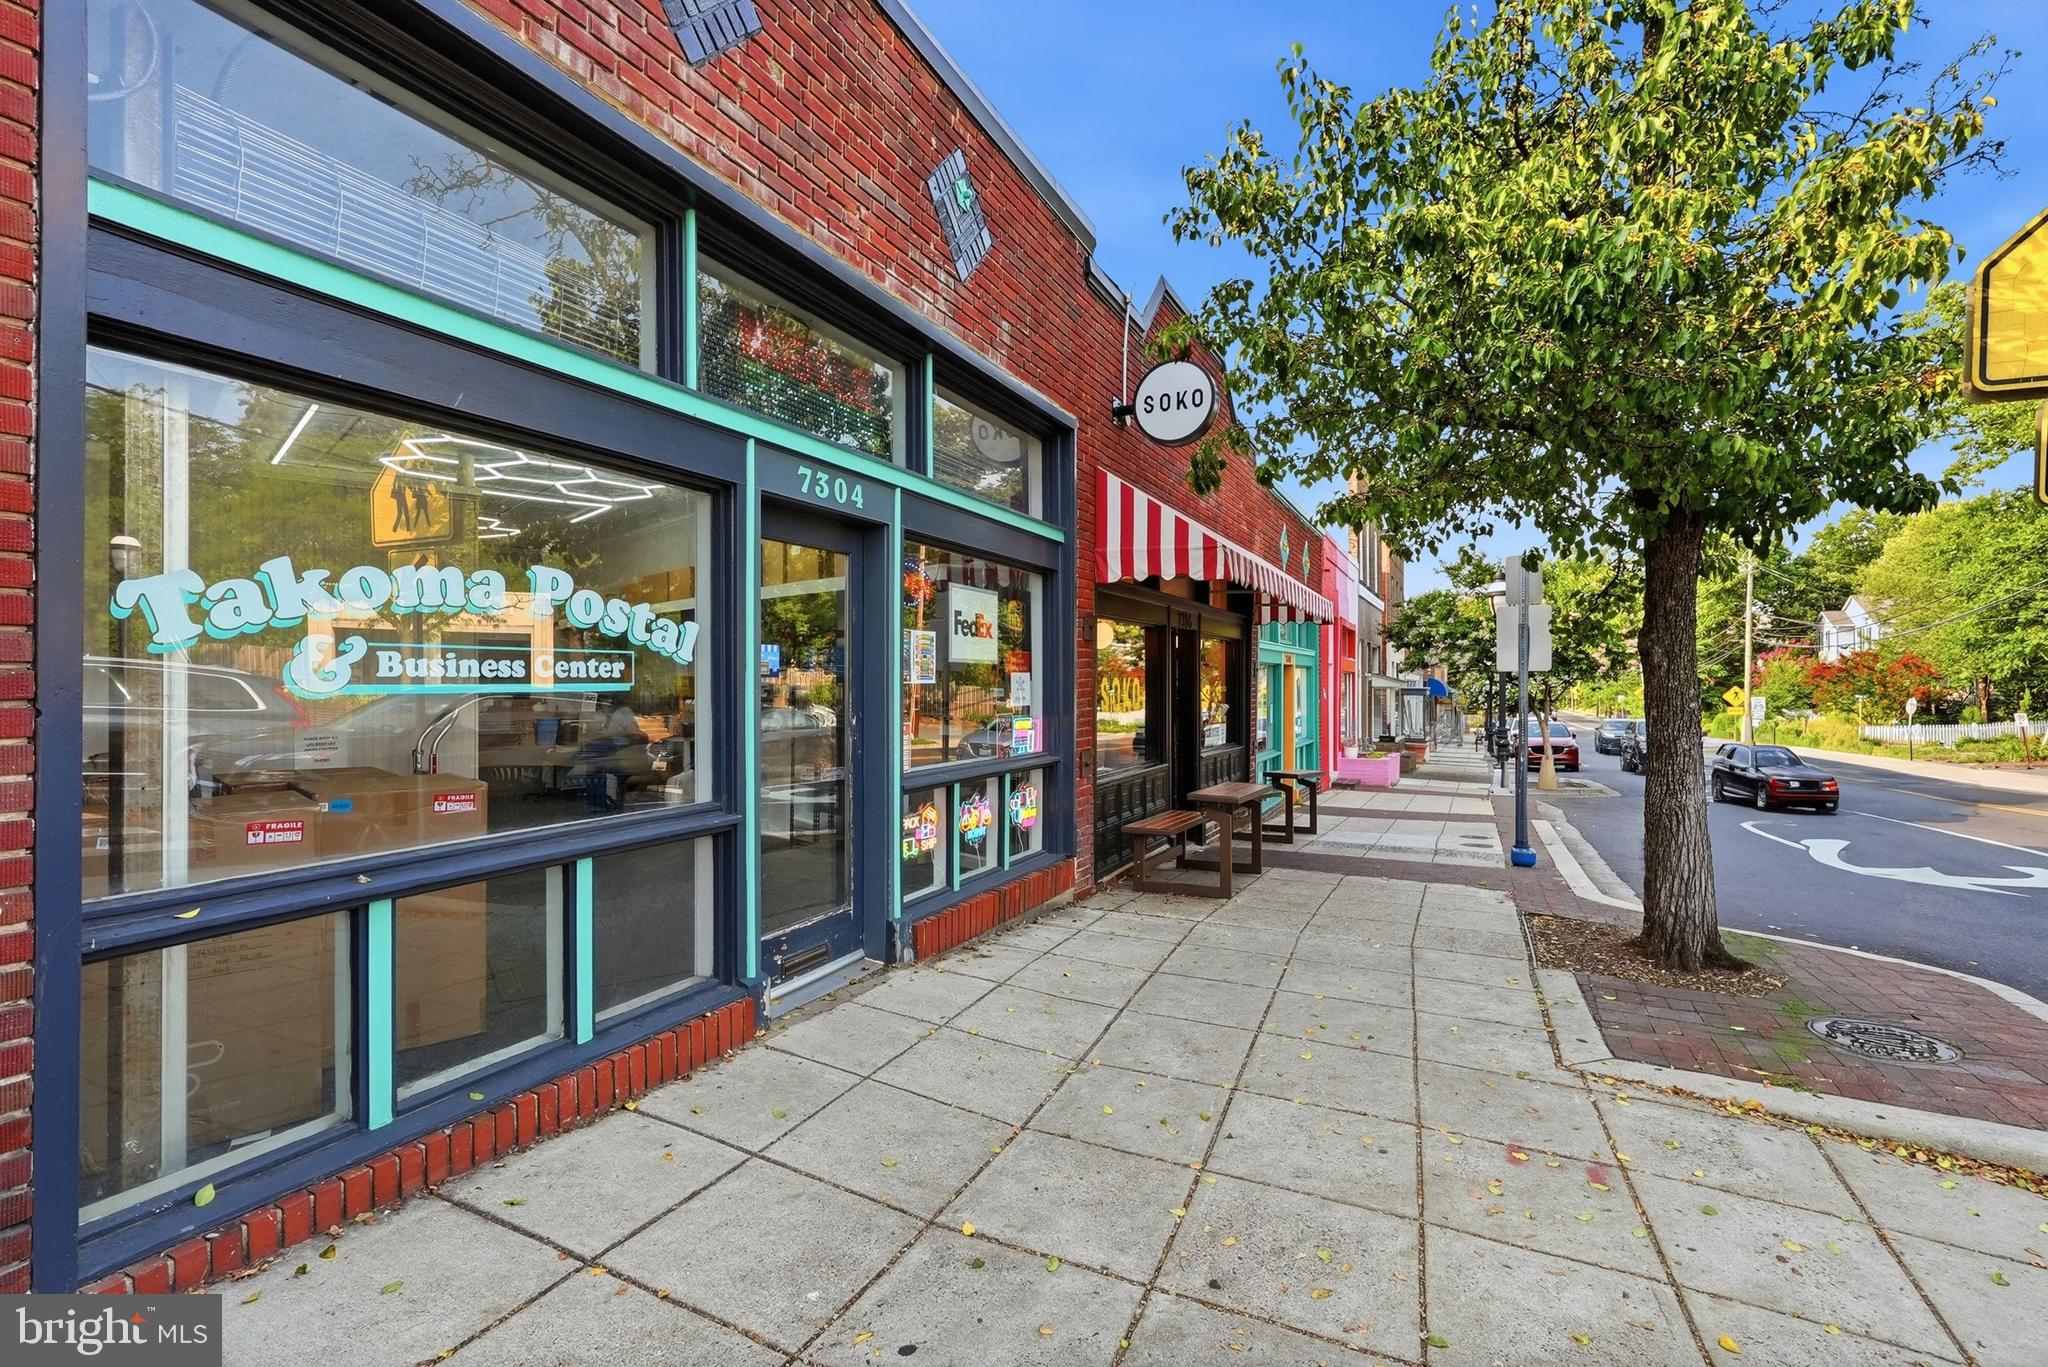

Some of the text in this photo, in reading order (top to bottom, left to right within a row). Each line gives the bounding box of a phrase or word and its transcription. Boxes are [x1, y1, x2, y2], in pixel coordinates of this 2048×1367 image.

[1143, 388, 1204, 414] SOKO
[797, 465, 864, 510] 7304
[111, 555, 700, 666] Takoma Postal
[953, 609, 994, 640] FedEx
[283, 634, 367, 700] &
[376, 650, 626, 679] Business Center
[265, 821, 304, 831] FRAGILE
